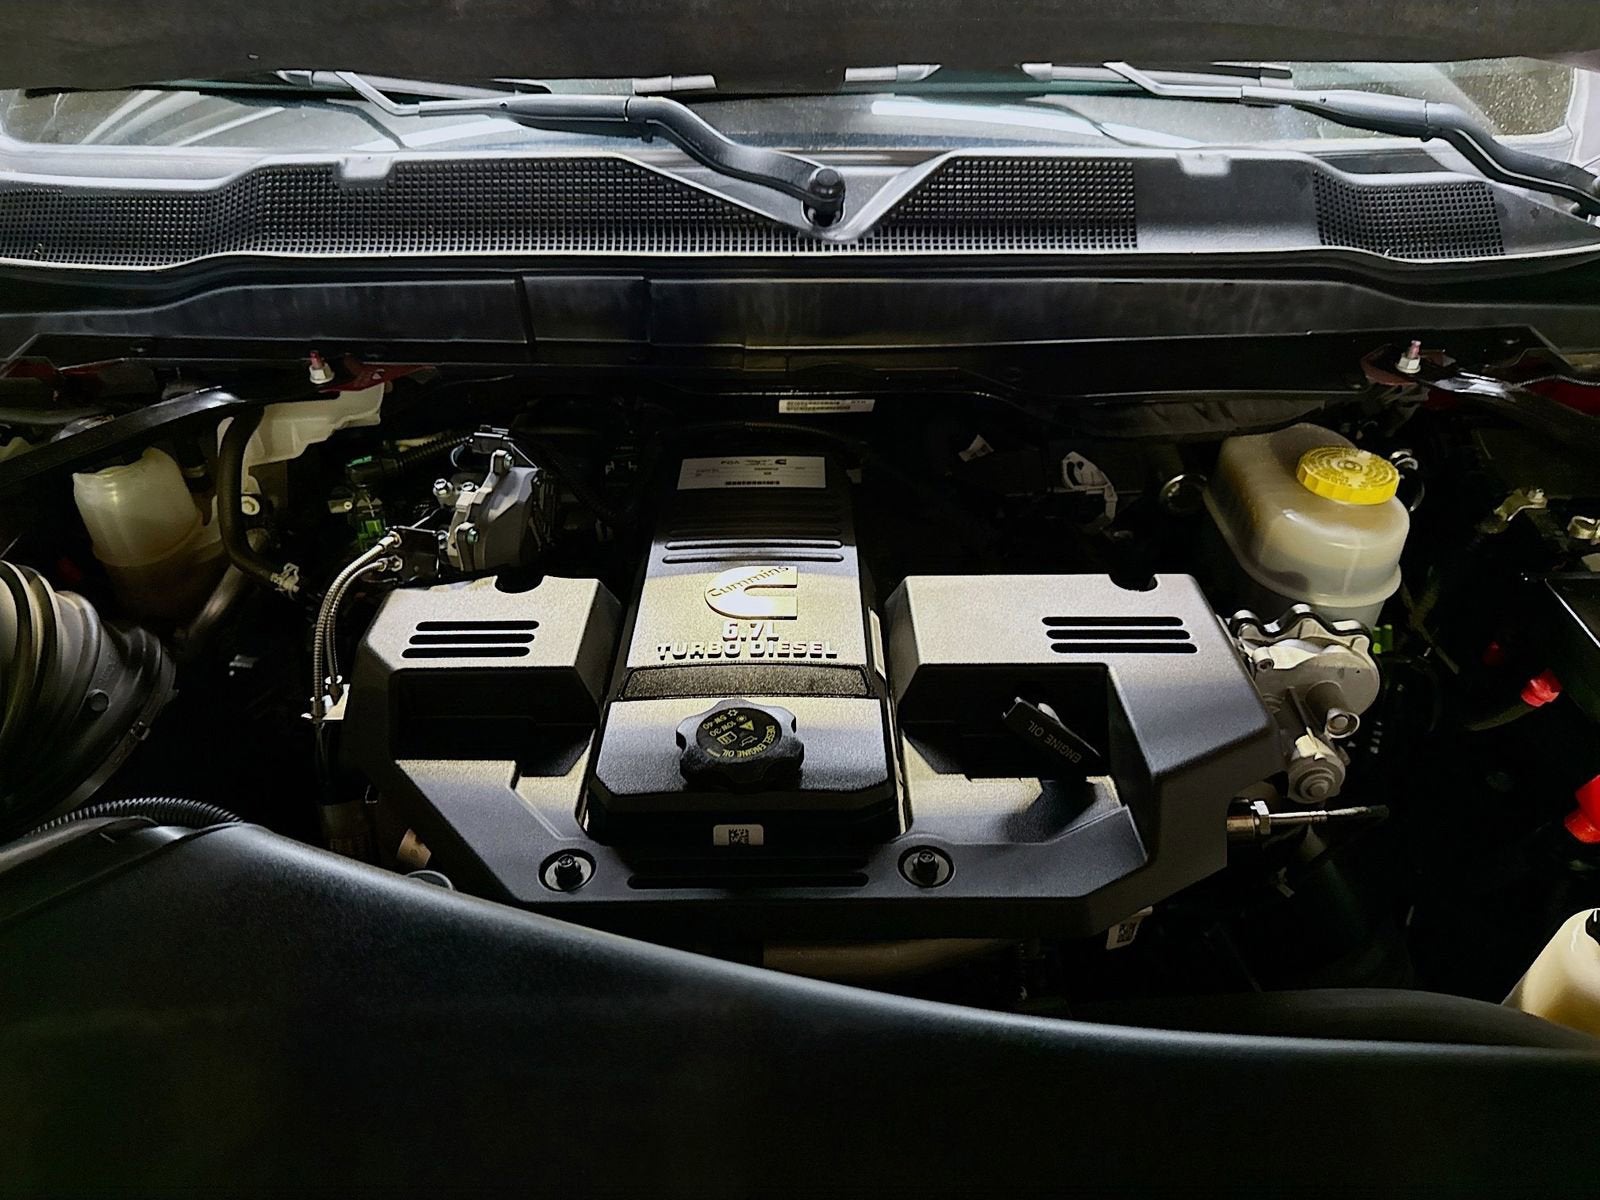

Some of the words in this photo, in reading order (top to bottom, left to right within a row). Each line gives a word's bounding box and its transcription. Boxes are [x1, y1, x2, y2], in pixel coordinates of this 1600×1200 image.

[707, 565, 789, 597] Cummins
[722, 622, 779, 641] 6.7L
[657, 640, 741, 660] TURBO
[749, 640, 837, 659] DIESEL
[1027, 720, 1044, 737] OIL
[721, 748, 735, 758] OIL
[736, 743, 767, 758] ENGINE
[1044, 733, 1082, 763] ENGINE
